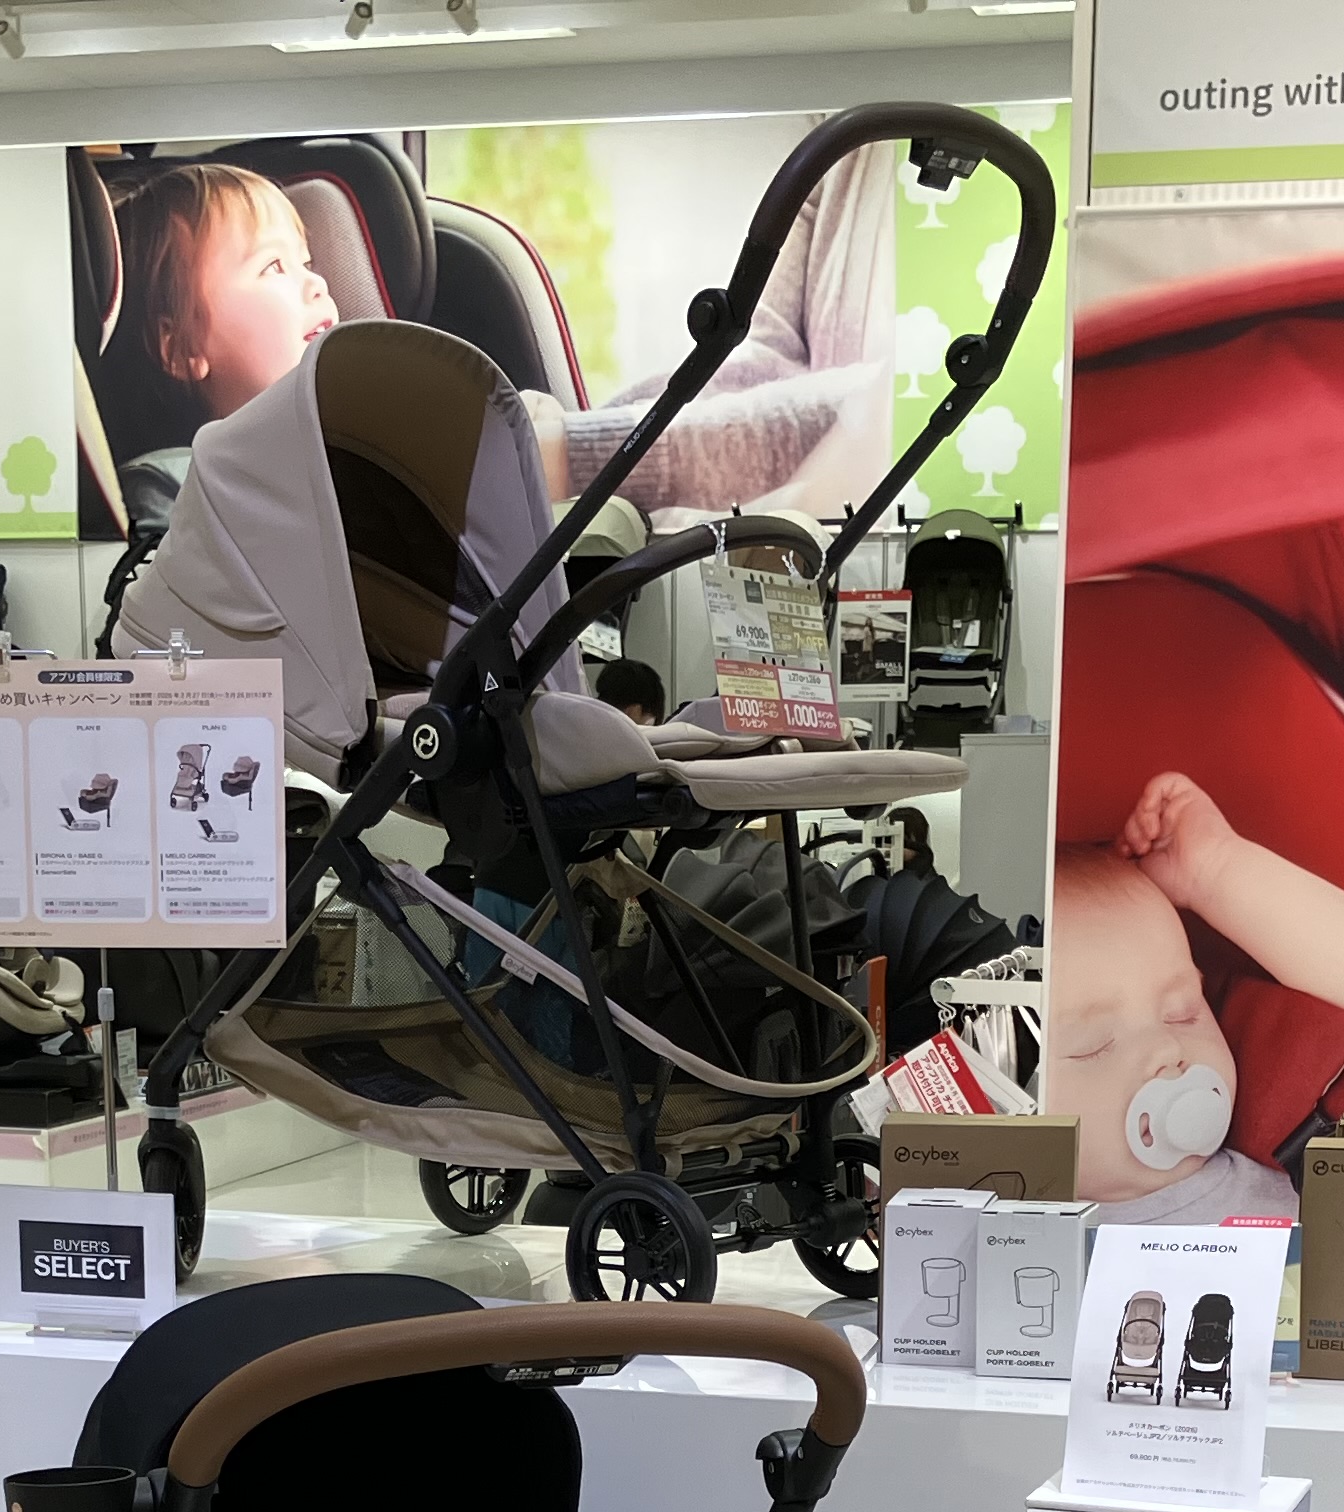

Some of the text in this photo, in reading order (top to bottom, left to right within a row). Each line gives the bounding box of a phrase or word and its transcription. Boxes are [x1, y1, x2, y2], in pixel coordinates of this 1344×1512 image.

[1159, 79, 1273, 117] outing
[911, 1145, 960, 1165] cybex
[905, 1226, 934, 1238] cybex
[53, 1239, 110, 1253] BUYER'S
[996, 1235, 1026, 1247] cybex
[1140, 1242, 1237, 1253] MELIO CARBON
[34, 1255, 131, 1281] SELECT
[986, 1348, 1041, 1358] CUP HOLDER
